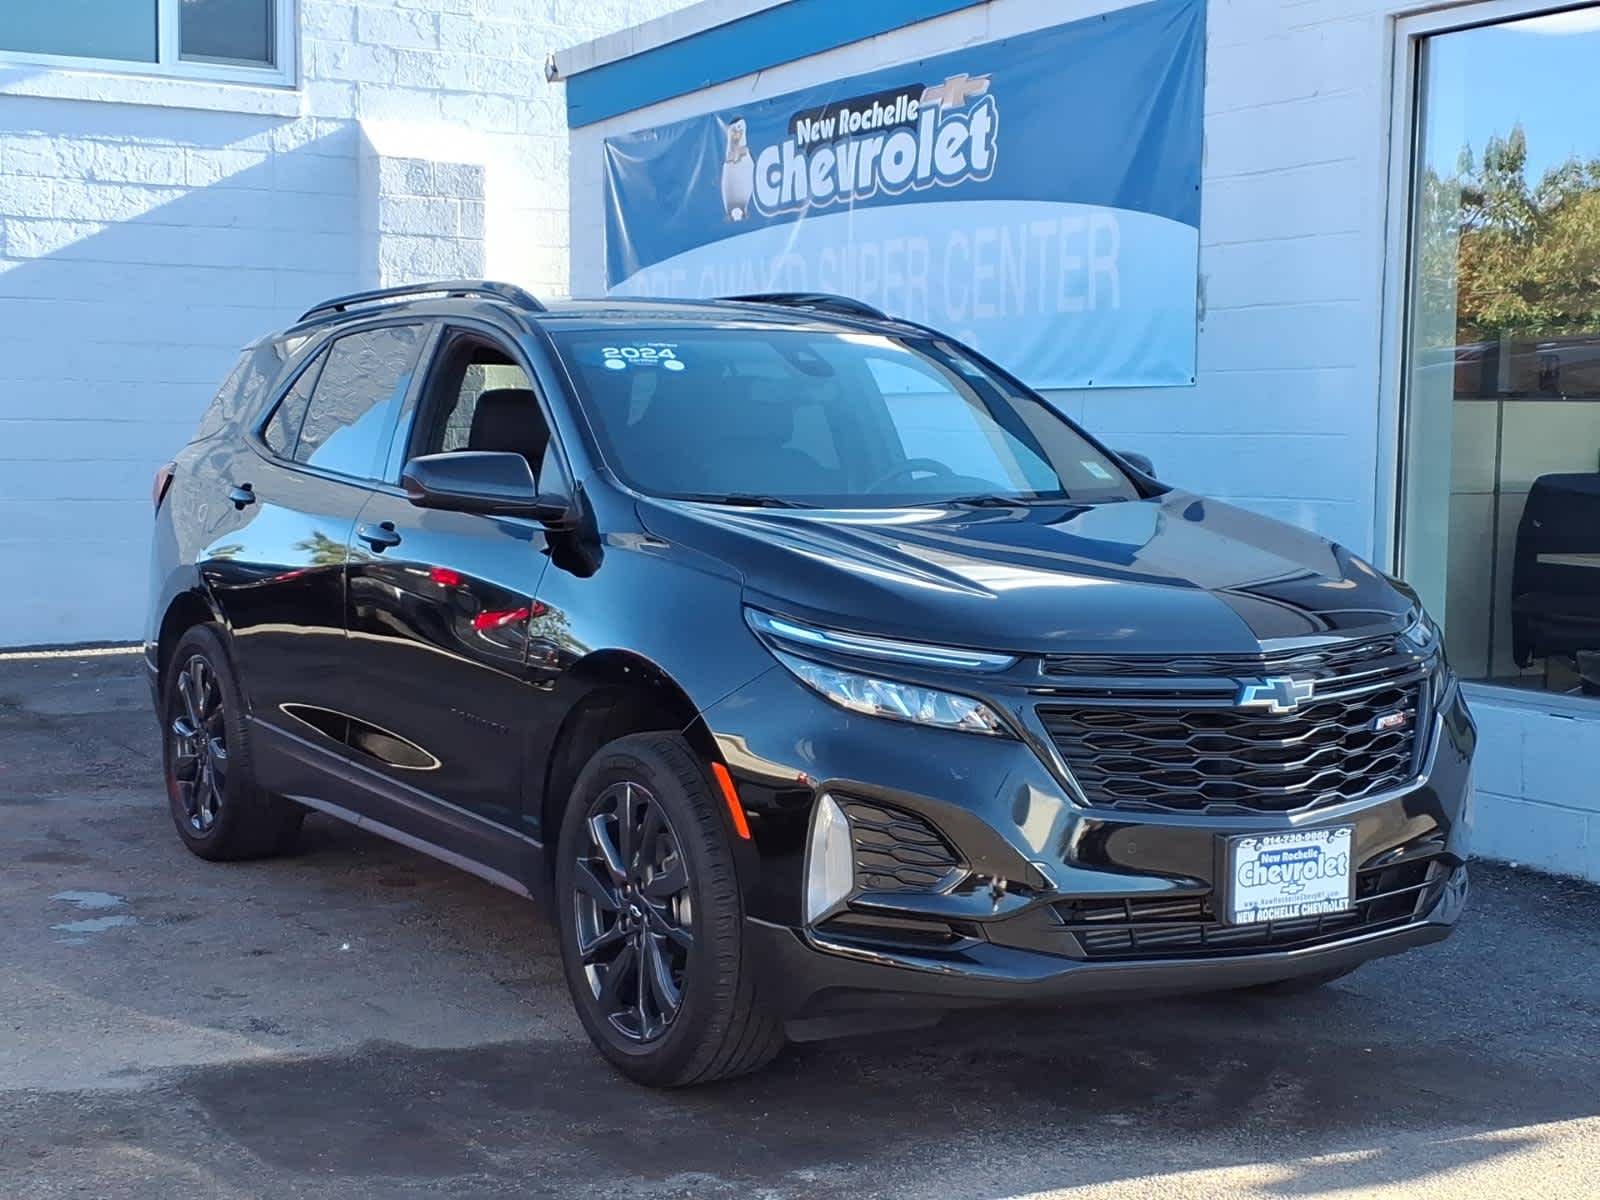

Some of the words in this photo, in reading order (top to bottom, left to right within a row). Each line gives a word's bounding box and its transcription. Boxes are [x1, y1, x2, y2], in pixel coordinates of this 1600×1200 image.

[796, 117, 835, 145] New
[839, 94, 919, 135] Rochelle
[755, 106, 991, 208] Chevrolet
[944, 212, 1120, 322] CENTER
[602, 347, 676, 359] 2024
[1238, 852, 1347, 888] Chevrolet
[1261, 853, 1280, 864] New
[1282, 848, 1318, 862] Rochelle
[1236, 910, 1256, 924] NEW
[1257, 904, 1300, 920] ROCHELLE
[1301, 898, 1349, 916] CHEVROLET
